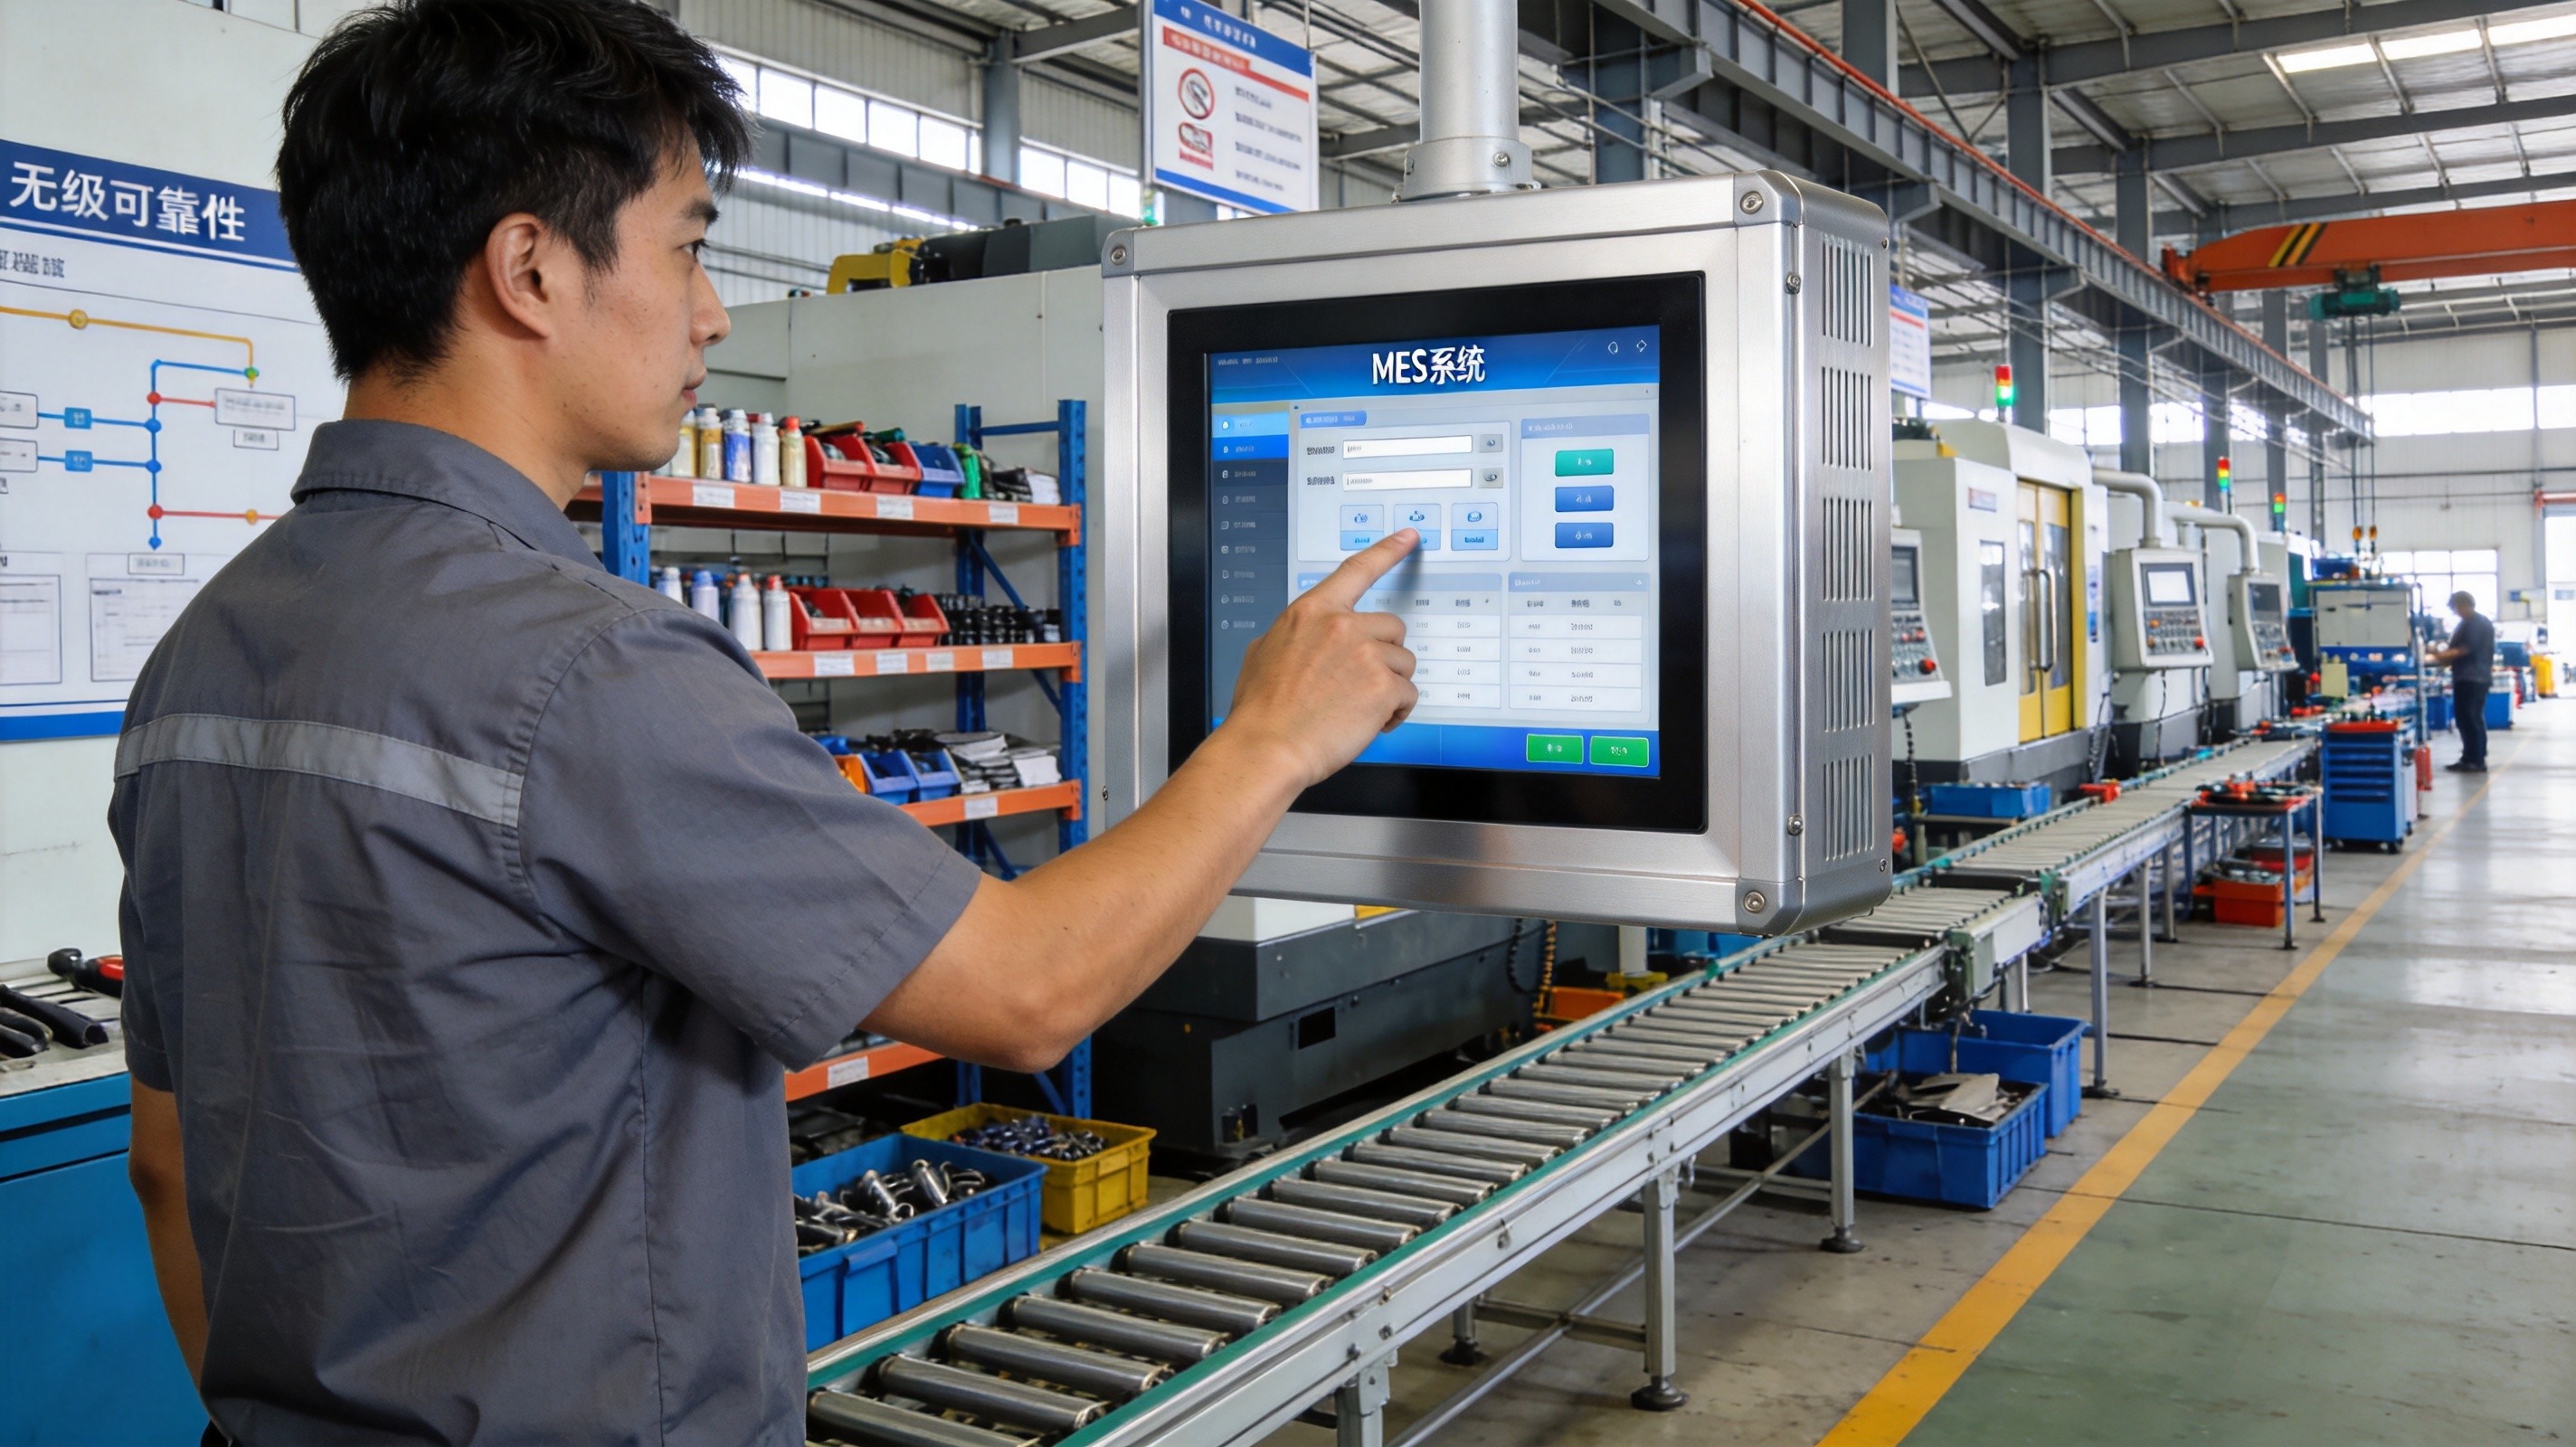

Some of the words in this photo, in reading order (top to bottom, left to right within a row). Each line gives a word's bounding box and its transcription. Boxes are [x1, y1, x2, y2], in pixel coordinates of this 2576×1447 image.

[9, 161, 245, 241] 无级可靠性
[1372, 345, 1485, 384] MES系统
